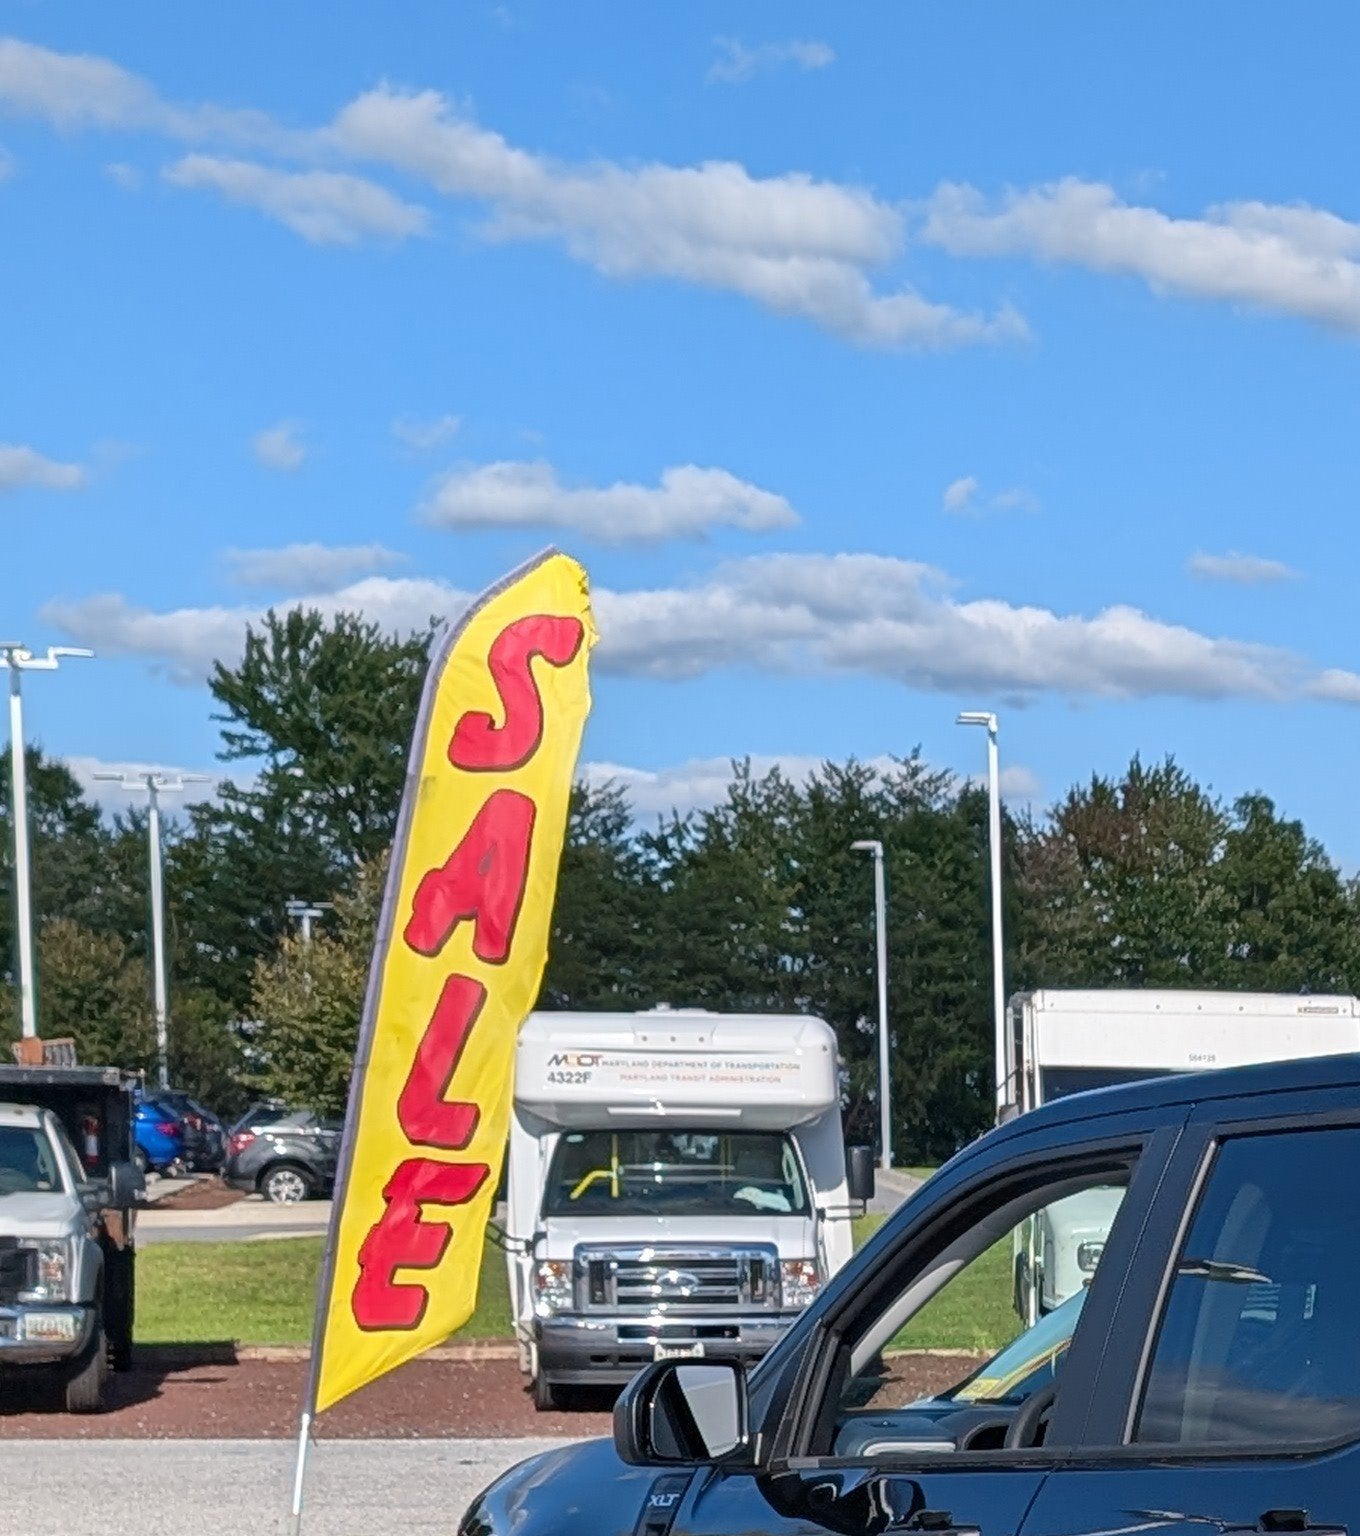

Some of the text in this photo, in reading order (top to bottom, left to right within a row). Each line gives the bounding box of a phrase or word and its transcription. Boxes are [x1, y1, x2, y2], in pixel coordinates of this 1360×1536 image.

[351, 614, 585, 1331] SALE
[710, 1060, 723, 1069] OF
[547, 1071, 592, 1084] 4322F
[647, 1493, 681, 1508] XLT
